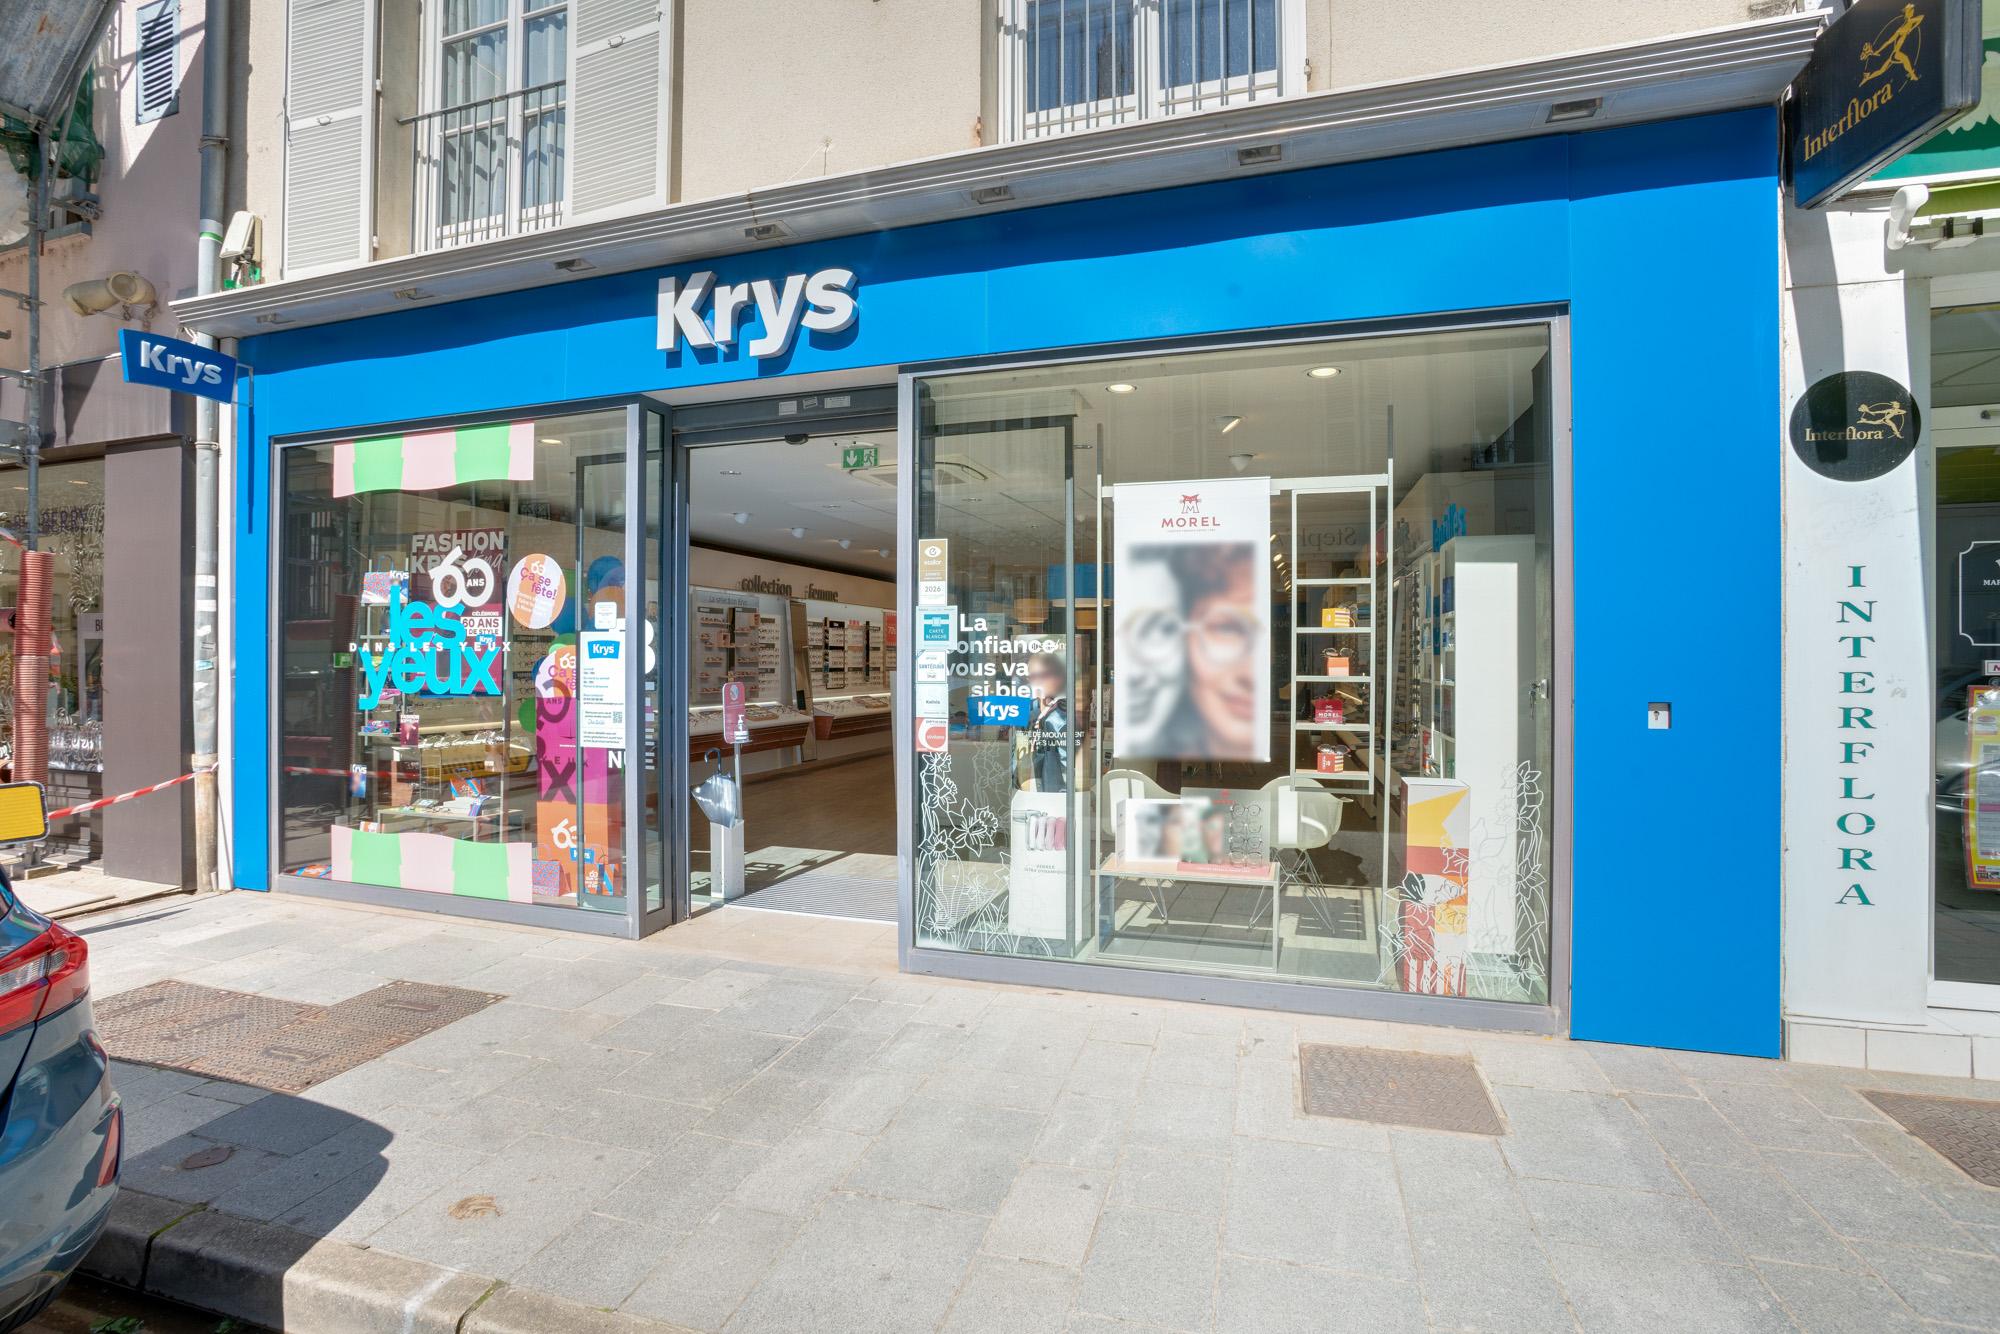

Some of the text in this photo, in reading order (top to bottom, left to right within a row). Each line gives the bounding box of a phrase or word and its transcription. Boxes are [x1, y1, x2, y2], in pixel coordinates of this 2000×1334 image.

[1803, 83, 1893, 161] Interflora
[656, 268, 859, 360] Krys
[141, 340, 222, 385] Krys
[1805, 426, 1883, 441] Interflora
[1161, 516, 1221, 528] MOREL
[412, 531, 505, 553] FASHION
[390, 570, 410, 581] Krys
[466, 578, 485, 587] ANS
[520, 567, 551, 586] Ça se
[531, 582, 557, 600] fête!
[741, 575, 838, 602] collection femme
[390, 584, 466, 650] les
[462, 618, 499, 628] 60 ANS
[960, 613, 988, 632] La
[349, 642, 511, 652] DANS LES YEUX
[592, 643, 615, 656] Krys
[358, 646, 502, 710] yeux
[946, 661, 1030, 677] vous va
[971, 681, 1045, 698] si bien
[977, 701, 1019, 720] Krys
[1042, 731, 1085, 739] MOUVEENT
[1836, 564, 1877, 906] INTERFLORA
